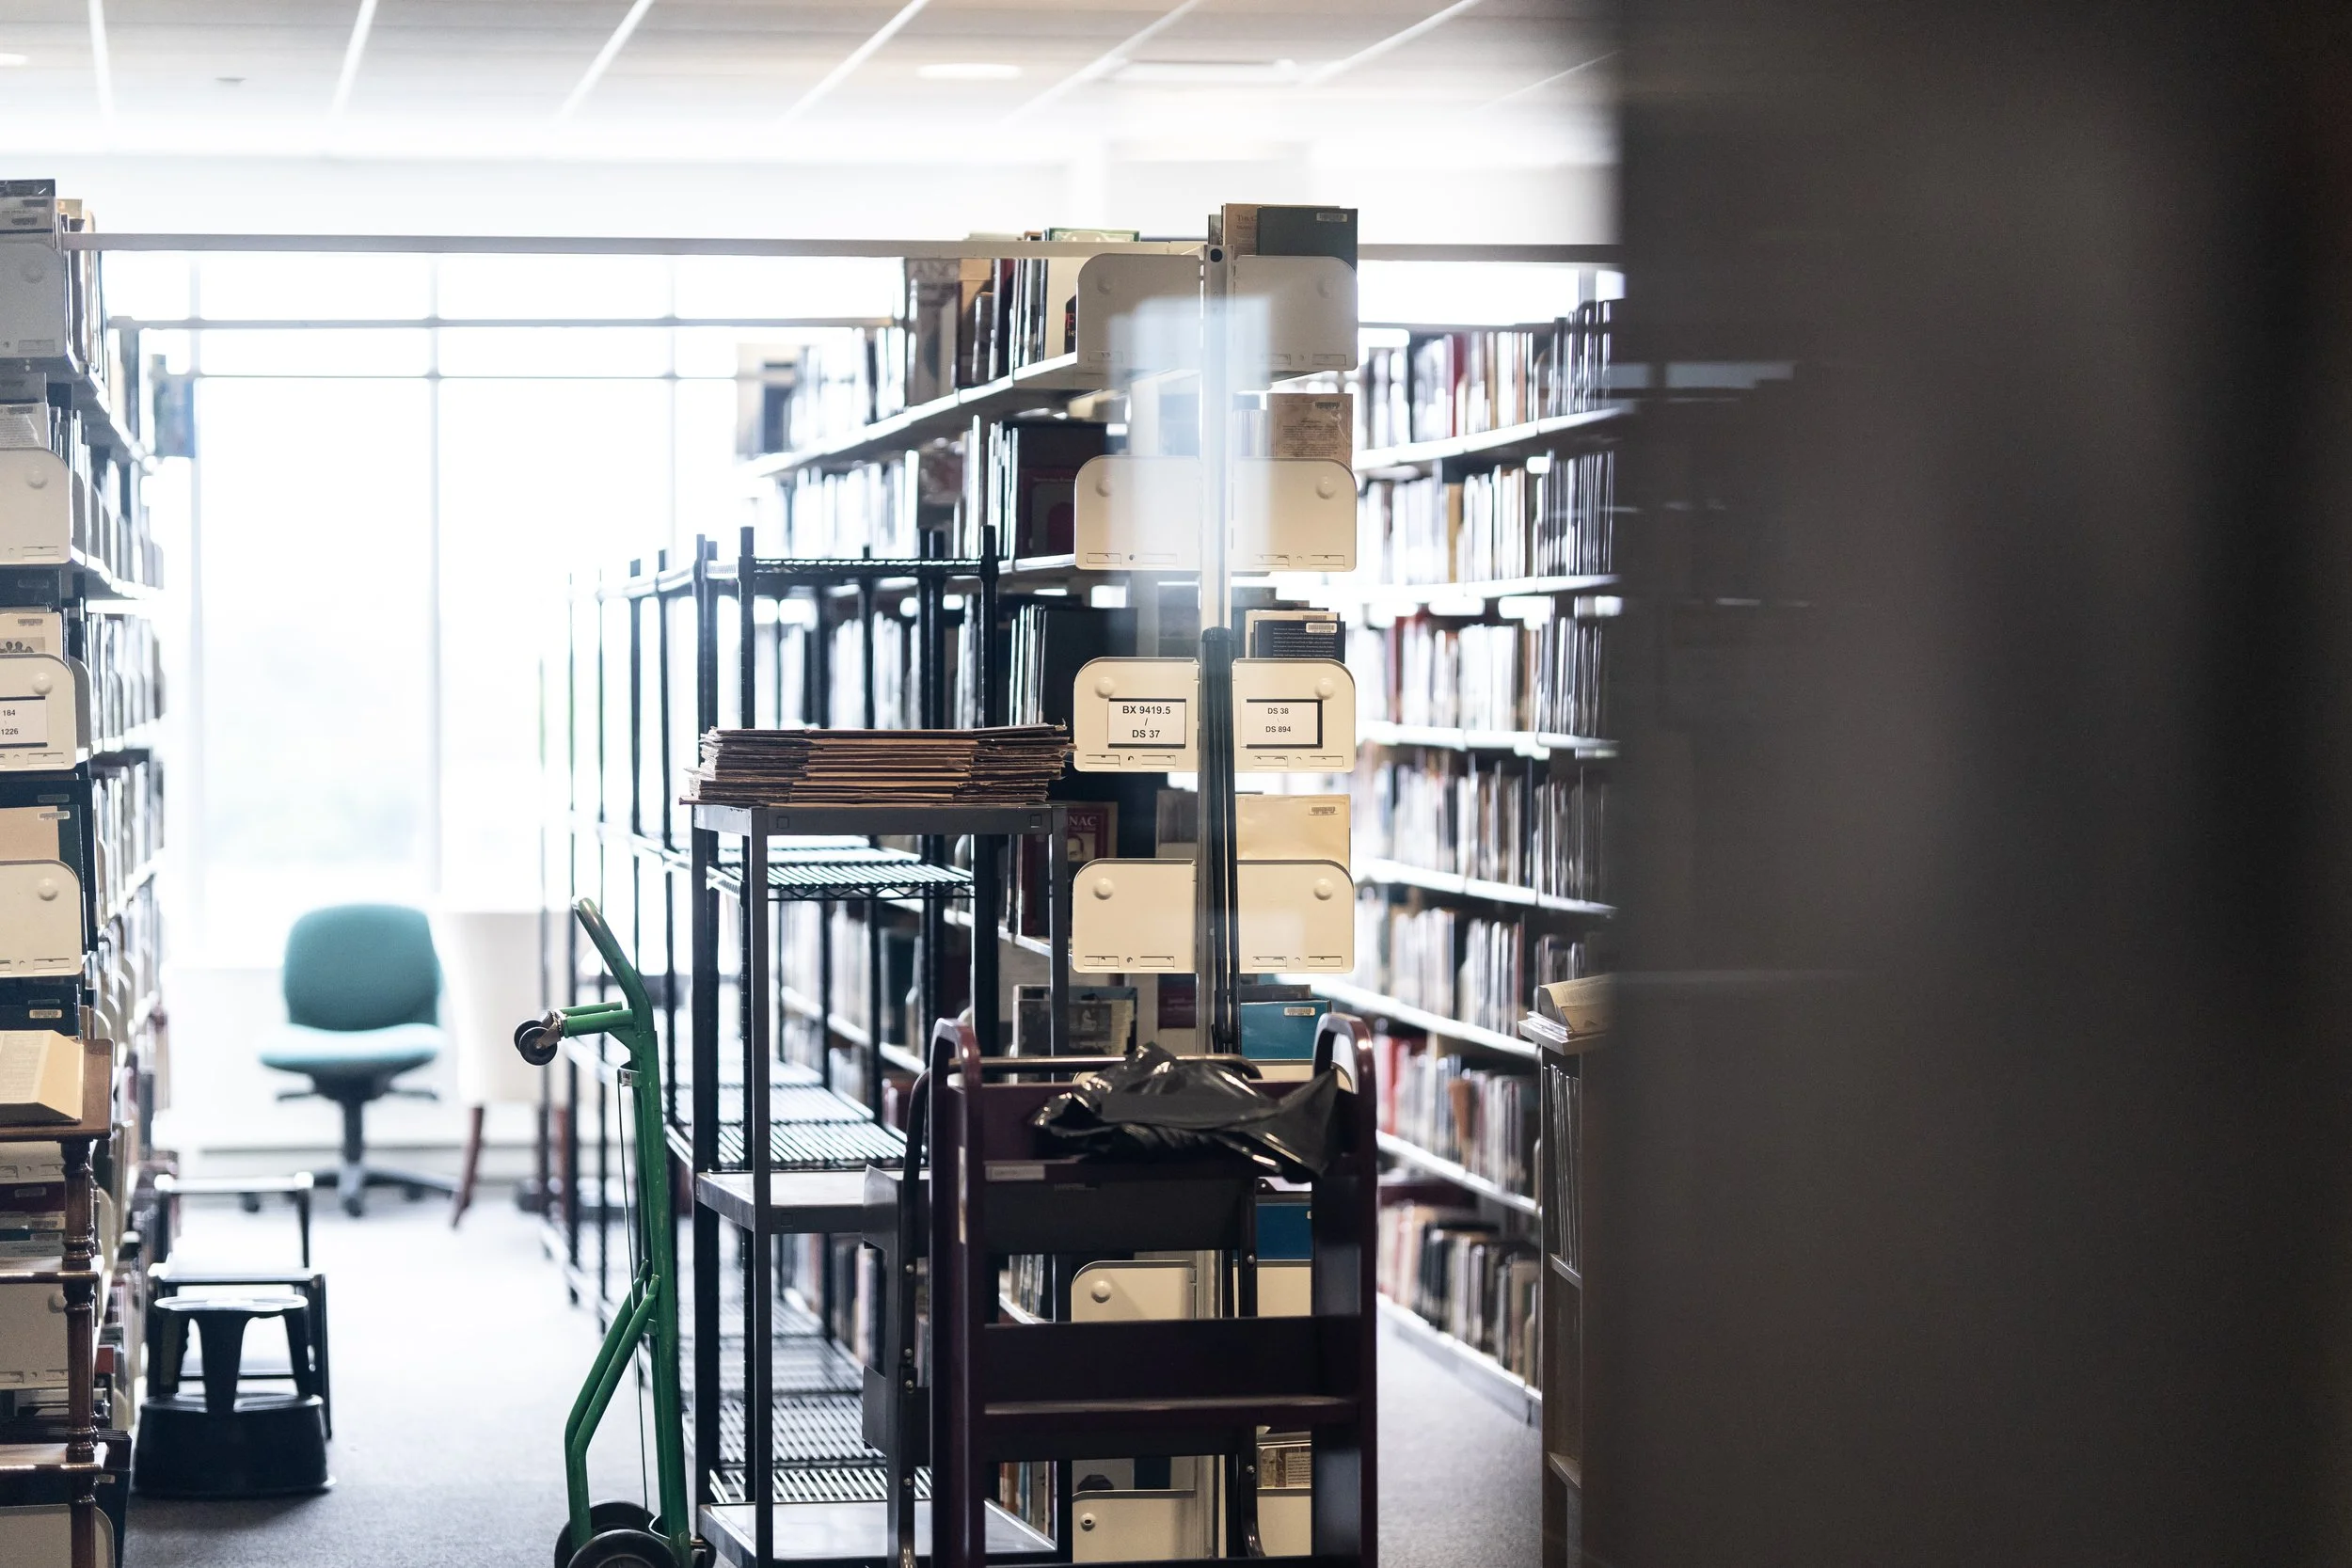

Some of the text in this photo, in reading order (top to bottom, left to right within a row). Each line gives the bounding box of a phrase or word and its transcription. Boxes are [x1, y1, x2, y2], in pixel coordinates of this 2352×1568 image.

[1122, 705, 1171, 715] BX 9419.5
[1132, 729, 1161, 738] DS 37
[1069, 816, 1097, 827] NAC
